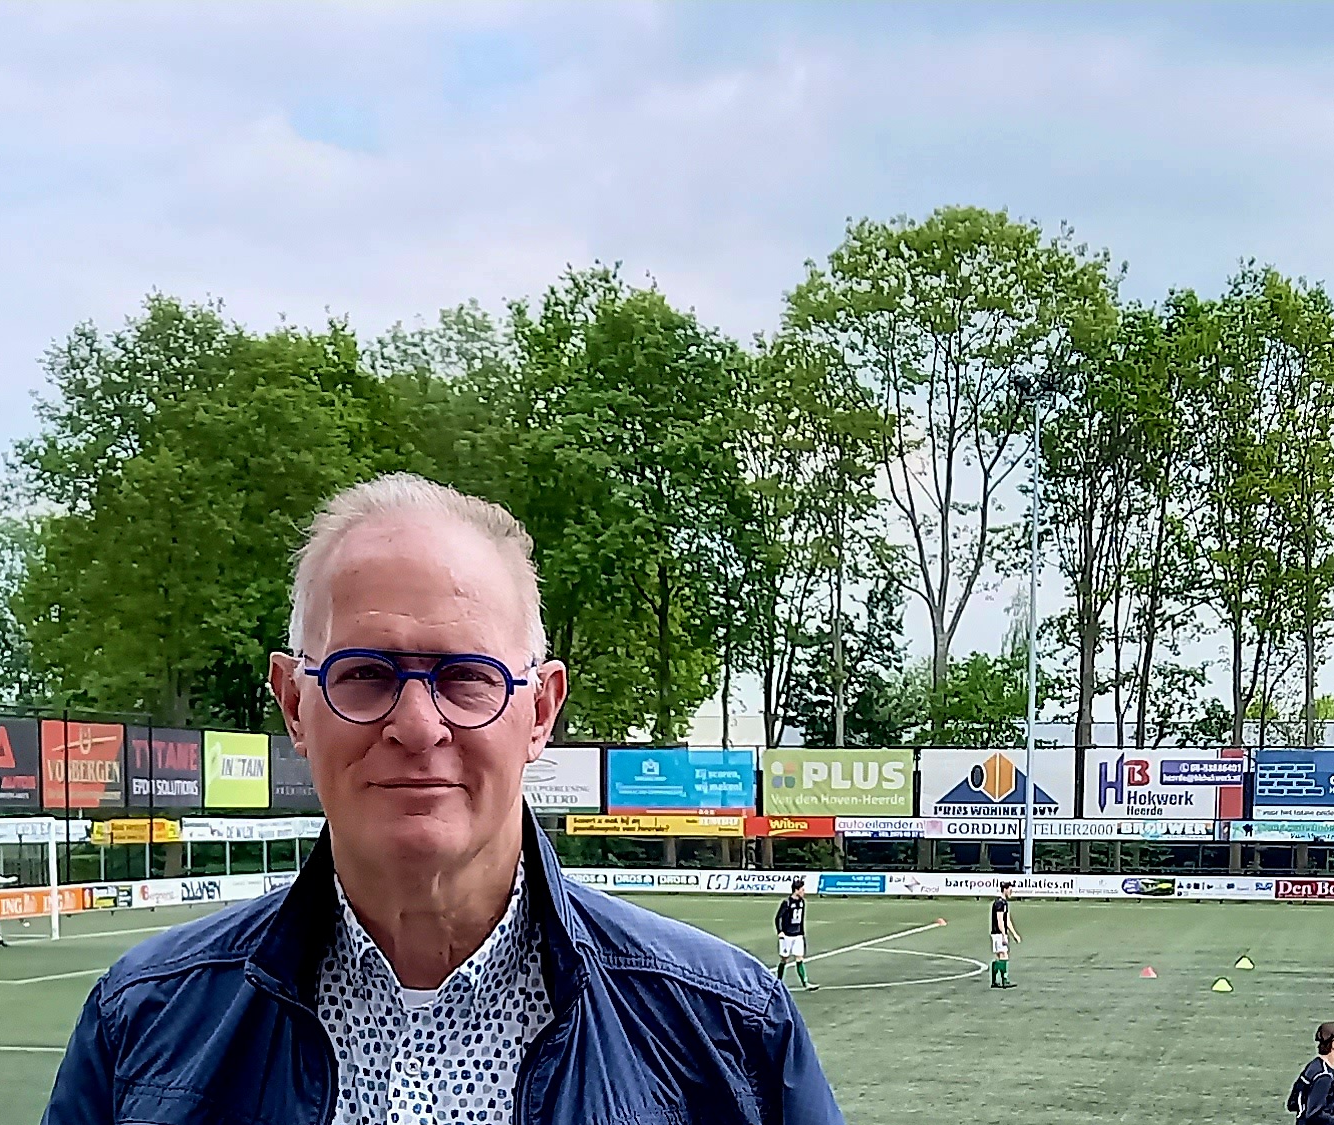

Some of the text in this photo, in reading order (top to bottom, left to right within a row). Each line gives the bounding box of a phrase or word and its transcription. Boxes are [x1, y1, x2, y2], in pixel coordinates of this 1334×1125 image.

[803, 761, 906, 790] PLUS
[156, 779, 199, 796] SOLUTIONS
[795, 794, 818, 805] den
[821, 794, 905, 806] Hoven-Heerde
[769, 819, 808, 830] Wibra
[947, 823, 1017, 834] GORDIJN
[1120, 822, 1207, 834] BROUWER
[733, 884, 775, 892] JANSEN
[1278, 881, 1313, 896] Den
[1, 897, 18, 914] ING
